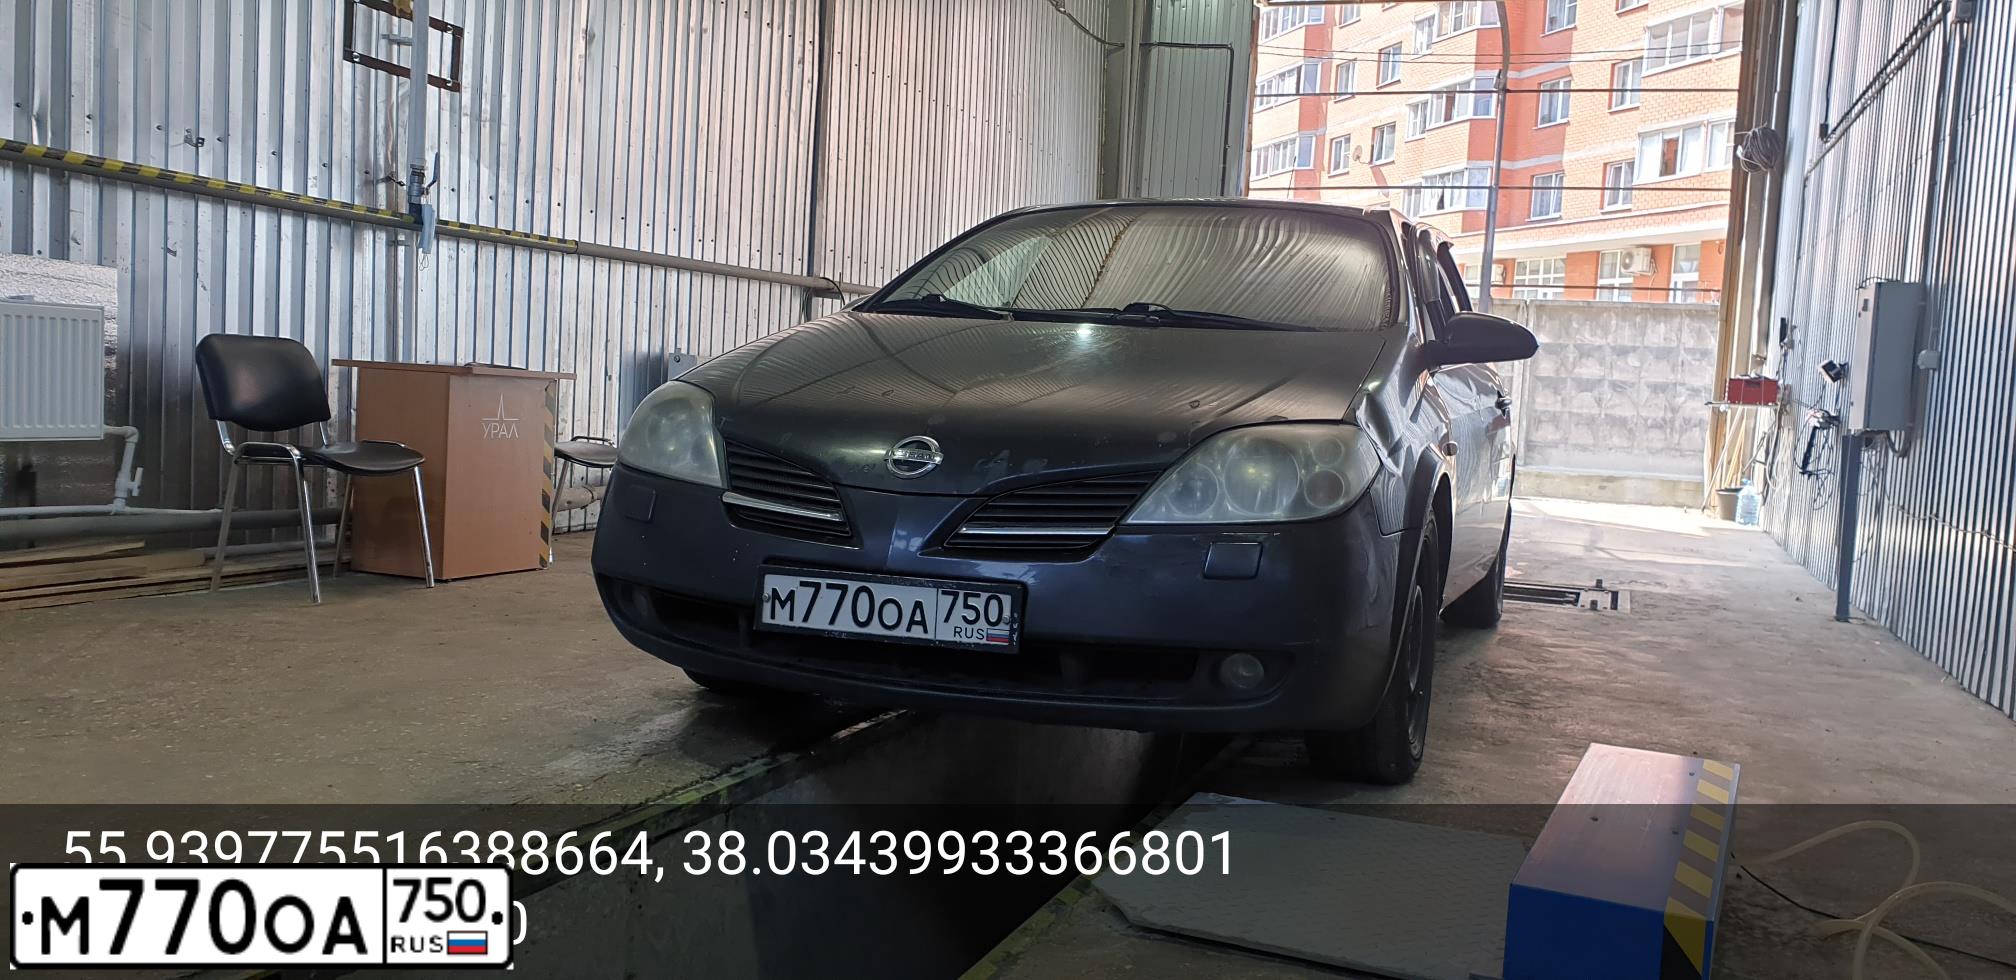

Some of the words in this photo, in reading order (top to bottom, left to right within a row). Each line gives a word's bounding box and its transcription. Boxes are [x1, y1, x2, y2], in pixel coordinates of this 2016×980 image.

[482, 422, 519, 439] УРАЛ
[769, 580, 929, 635] М770ОА
[941, 589, 1004, 627] 750
[953, 626, 985, 640] RUS
